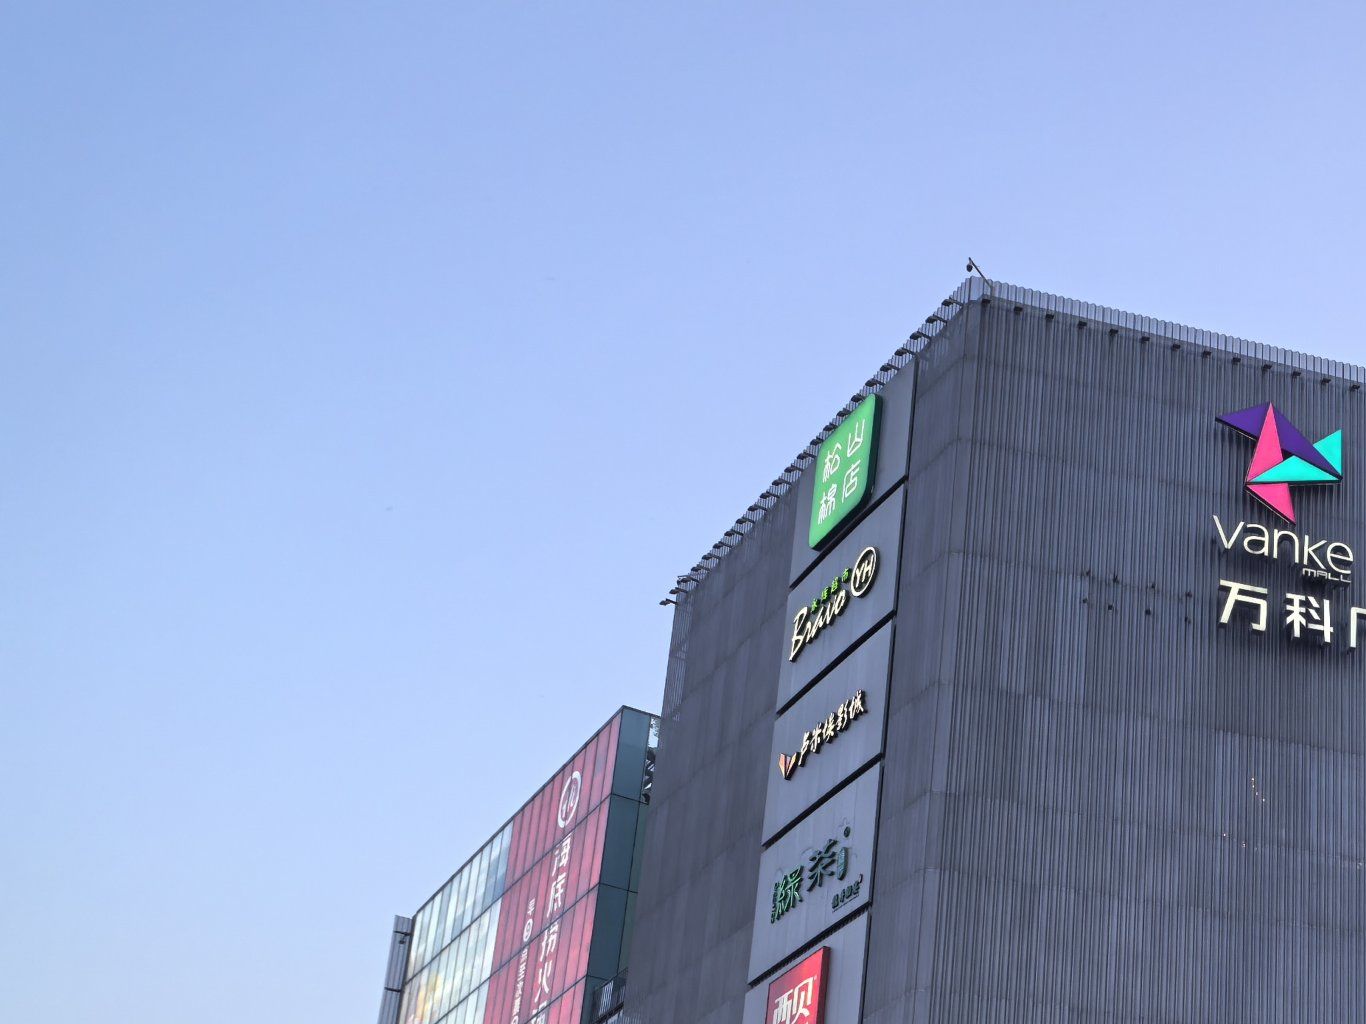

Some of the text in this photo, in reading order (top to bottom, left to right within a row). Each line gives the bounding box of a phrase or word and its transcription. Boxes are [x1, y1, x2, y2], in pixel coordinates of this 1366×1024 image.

[822, 419, 865, 483] 松山
[818, 460, 861, 525] 棉店
[1213, 515, 1353, 575] vanke
[1302, 567, 1352, 583] MALL
[789, 606, 846, 661] Bravo
